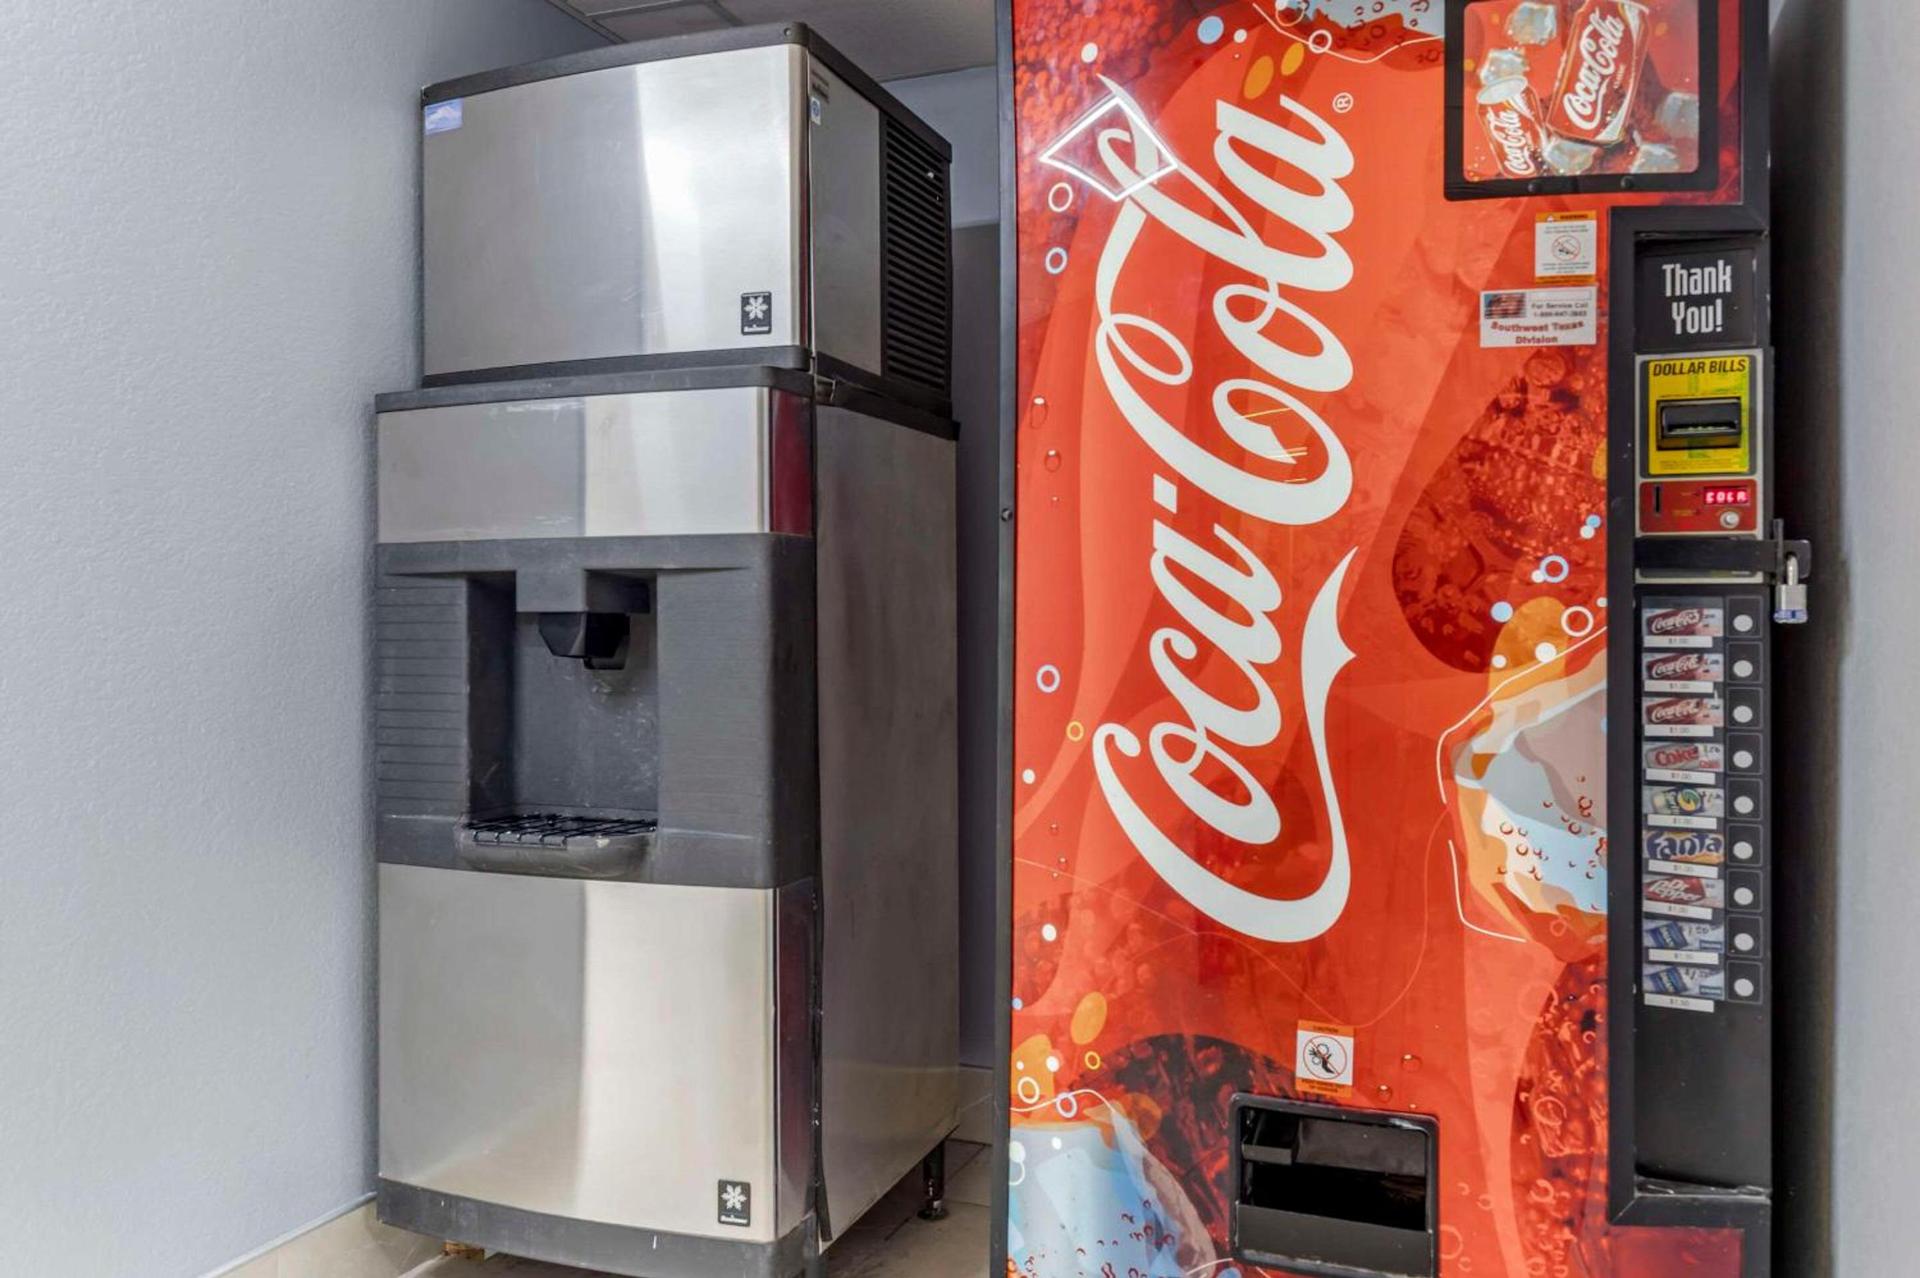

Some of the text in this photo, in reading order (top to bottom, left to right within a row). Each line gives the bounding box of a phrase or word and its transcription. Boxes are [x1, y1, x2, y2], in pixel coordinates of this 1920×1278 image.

[1662, 260, 1732, 297] Thank
[1491, 321, 1584, 332] Southwest Texas
[1671, 299, 1722, 335] You!
[1515, 335, 1558, 344] Division
[1653, 359, 1746, 376] DOLLAR BILLS
[1092, 74, 1358, 943] Coca-Cola
